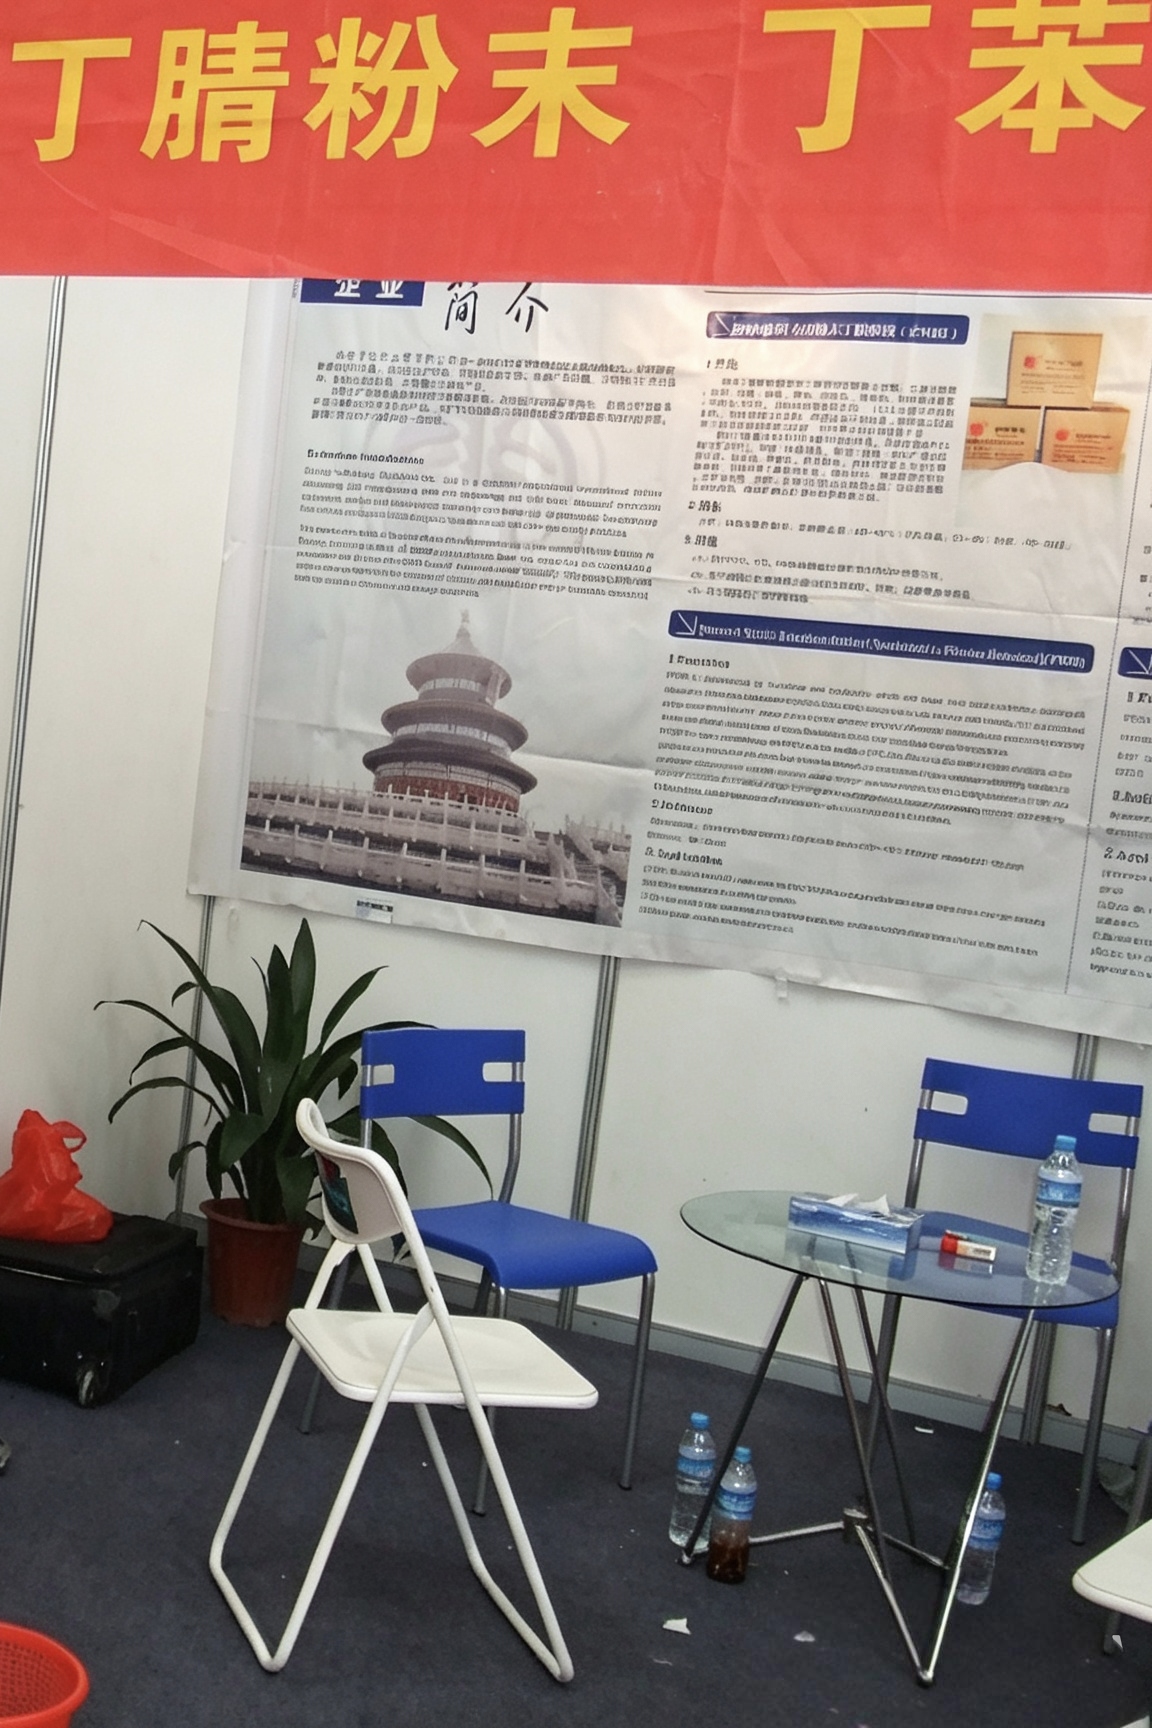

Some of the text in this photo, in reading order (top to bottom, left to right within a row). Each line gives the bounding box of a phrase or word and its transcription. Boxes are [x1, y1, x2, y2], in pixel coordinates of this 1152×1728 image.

[12, 7, 635, 163] 丁腈粉末
[444, 281, 550, 335] 简介
